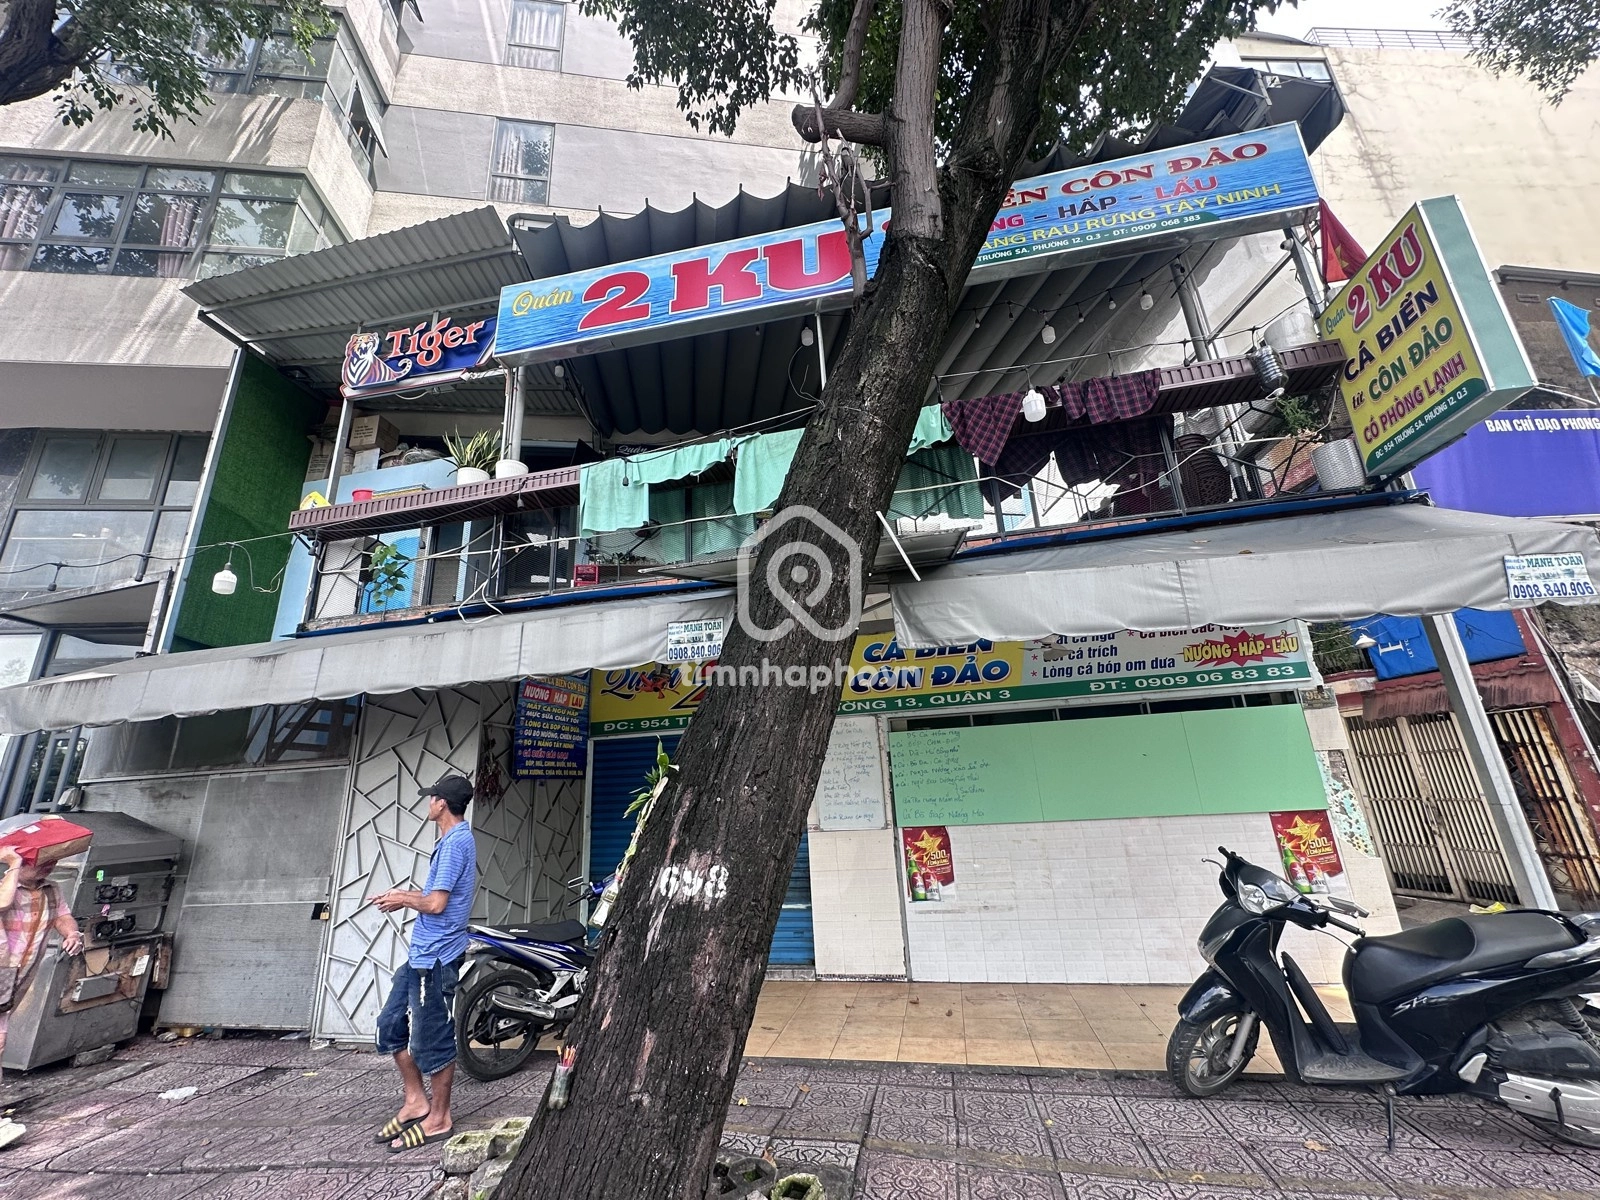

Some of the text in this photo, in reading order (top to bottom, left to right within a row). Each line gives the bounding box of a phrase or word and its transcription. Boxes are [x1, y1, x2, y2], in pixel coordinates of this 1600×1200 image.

[1061, 143, 1268, 194] CÔN ĐẢO
[1033, 222, 1079, 240] RAU
[1086, 208, 1156, 230] RỪNG
[1162, 197, 1208, 216] TÂY
[1216, 183, 1282, 205] NINH
[1058, 194, 1117, 219] HẤP
[1131, 222, 1157, 234] 0909
[1160, 218, 1180, 227] 068
[1183, 214, 1201, 224] 383
[512, 230, 853, 332] Quán 2 KU
[1325, 222, 1423, 335] Quán 2 KU
[385, 317, 485, 367] Tiger
[1344, 280, 1440, 382] CÁ BIỂN
[1369, 355, 1407, 401] CÔN
[1409, 315, 1452, 370] ĐẢO
[1380, 384, 1424, 432] PHÒNG
[1424, 351, 1467, 398] LẠNH
[1485, 419, 1513, 432] BAN
[1513, 415, 1535, 431] CHỈ
[1534, 418, 1561, 433] ĐẠO
[1384, 440, 1395, 453] 954
[1512, 581, 1595, 599] 0908.840.906
[668, 643, 721, 660] 0908.840.906
[1068, 647, 1084, 660] cá
[1087, 644, 1118, 658] trích
[850, 655, 1012, 694] CÔN ĐẢO
[1043, 665, 1073, 679] Lòng
[1077, 662, 1093, 675] cá
[1125, 660, 1146, 671] om
[1151, 657, 1175, 669] dưa
[1089, 665, 1295, 692] ĐT: 0909 06 83 83
[930, 690, 991, 705] QUẬN
[999, 690, 1011, 699] 3
[604, 721, 634, 731] ĐC:
[640, 718, 670, 729] 954
[1308, 836, 1328, 849] 500
